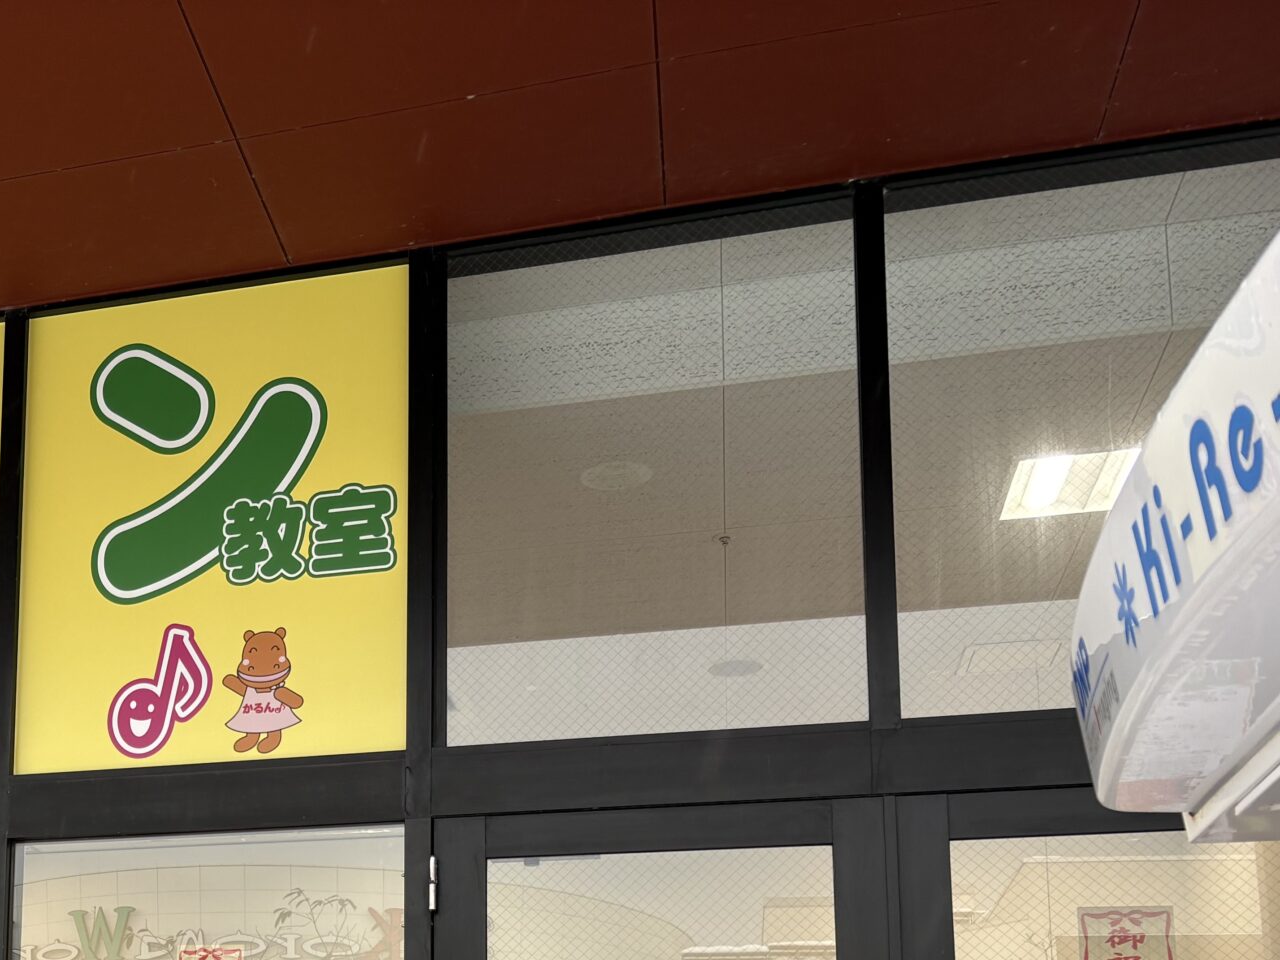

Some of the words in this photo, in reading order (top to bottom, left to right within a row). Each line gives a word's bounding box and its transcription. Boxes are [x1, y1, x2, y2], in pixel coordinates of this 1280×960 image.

[220, 482, 398, 586] 教室
[242, 701, 274, 715] かるん
